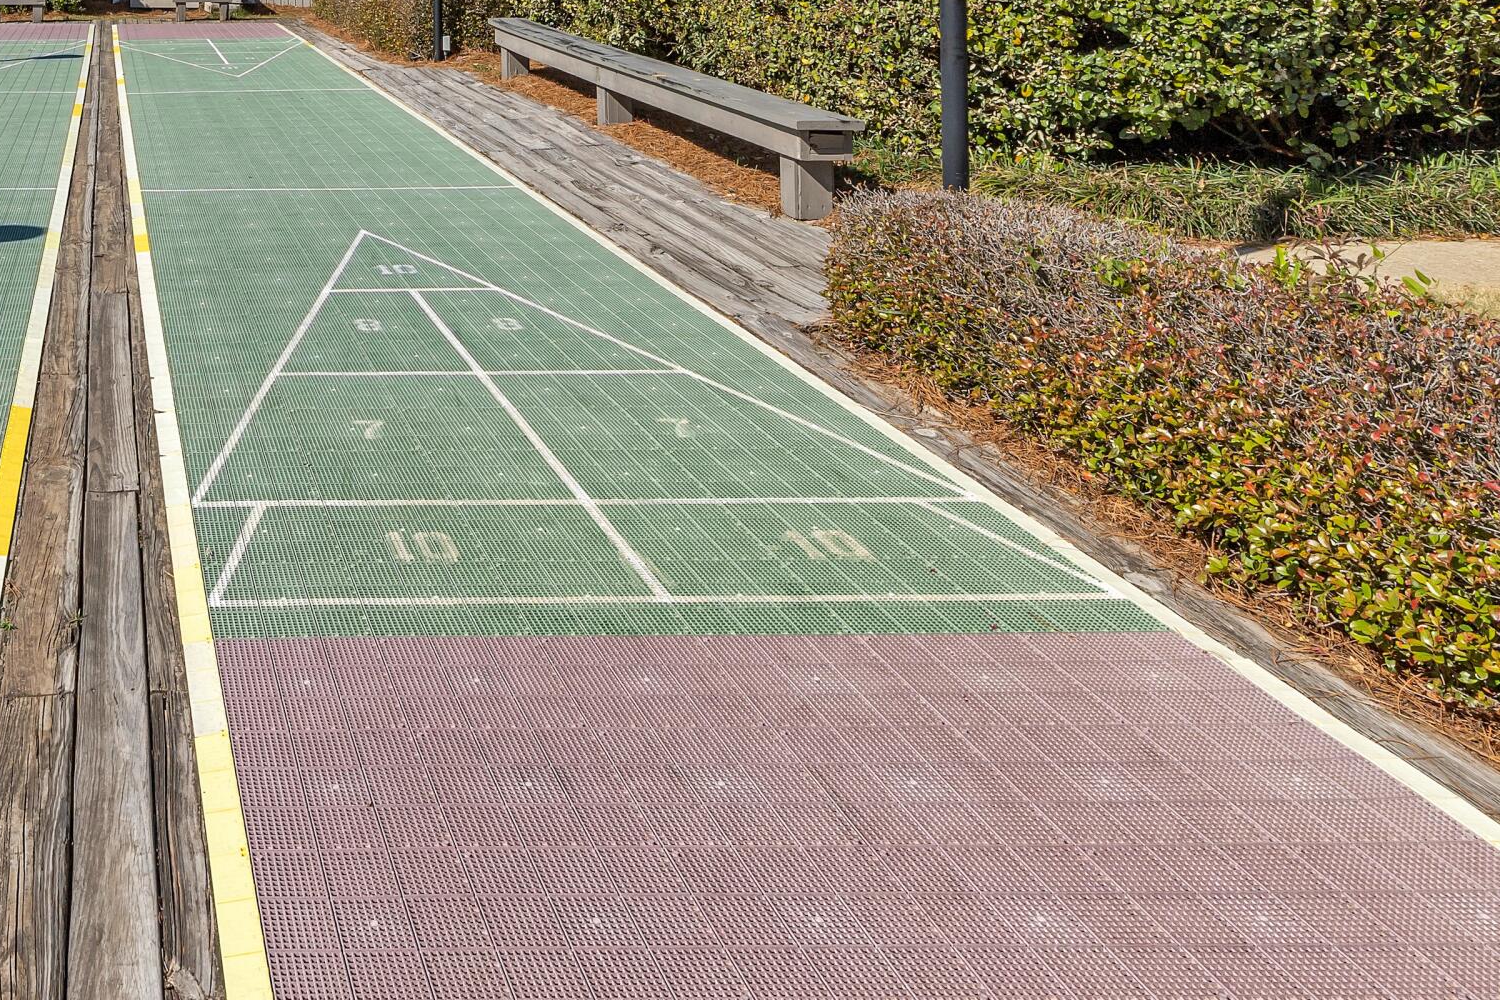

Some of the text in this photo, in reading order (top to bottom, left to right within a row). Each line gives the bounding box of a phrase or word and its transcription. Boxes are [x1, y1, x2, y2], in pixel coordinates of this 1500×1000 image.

[374, 264, 417, 275] 10
[352, 420, 385, 439] 7
[659, 418, 694, 437] 7
[385, 530, 461, 563] 10
[780, 527, 876, 561] 10
